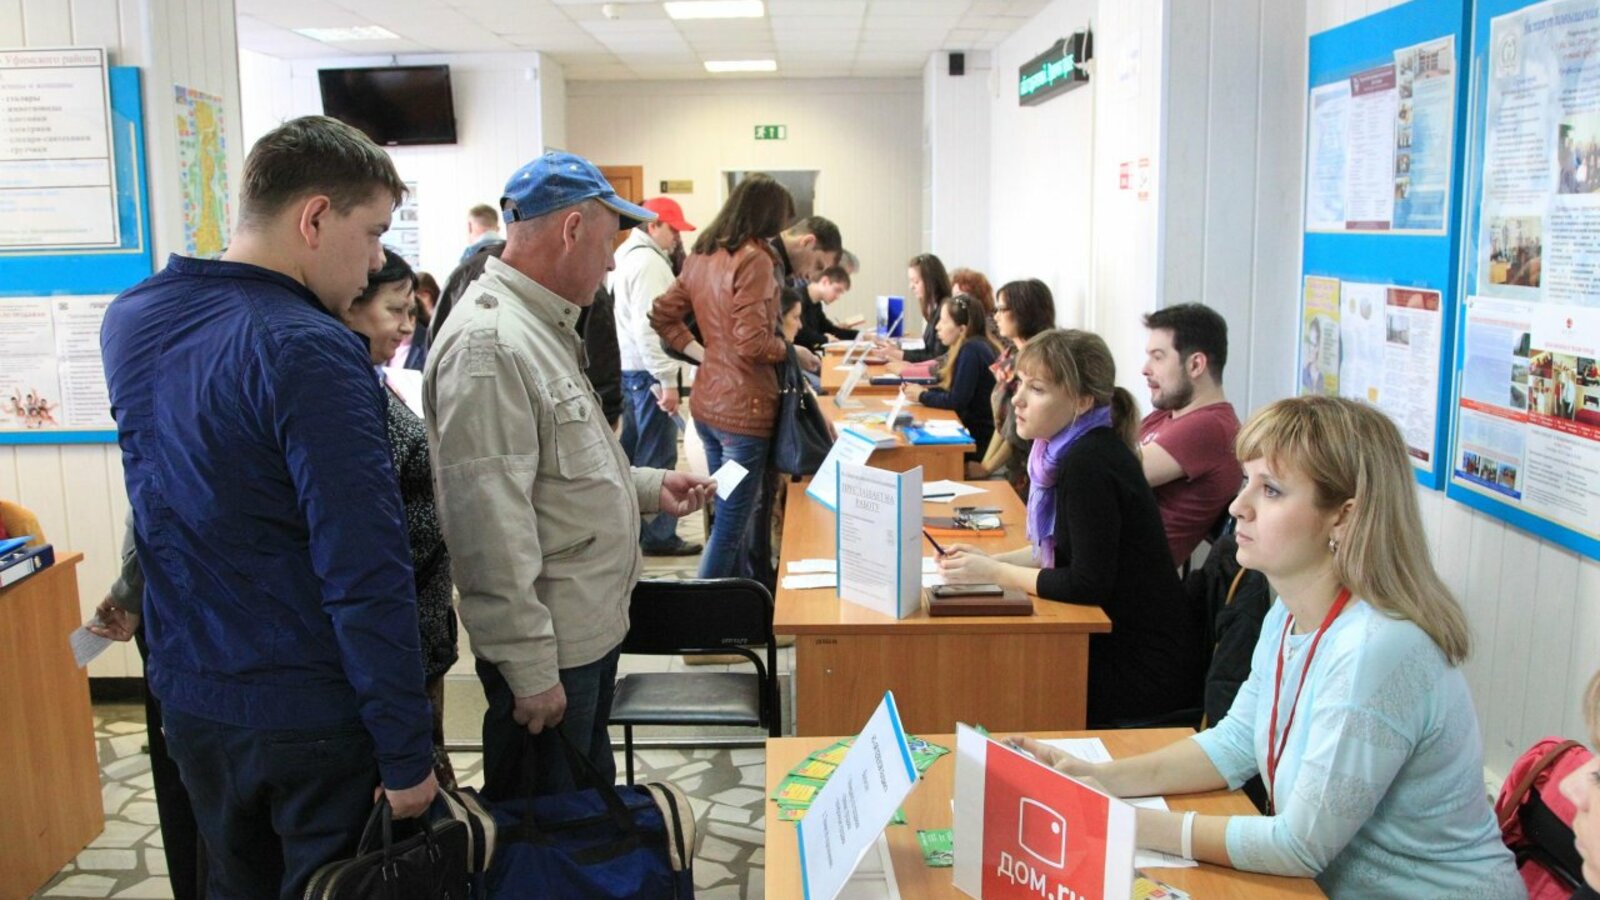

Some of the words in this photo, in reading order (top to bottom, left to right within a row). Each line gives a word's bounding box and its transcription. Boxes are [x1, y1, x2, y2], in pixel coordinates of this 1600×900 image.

[5, 53, 59, 67] Уфимского
[62, 53, 97, 65] района
[997, 851, 1085, 900] ДОМ.r
